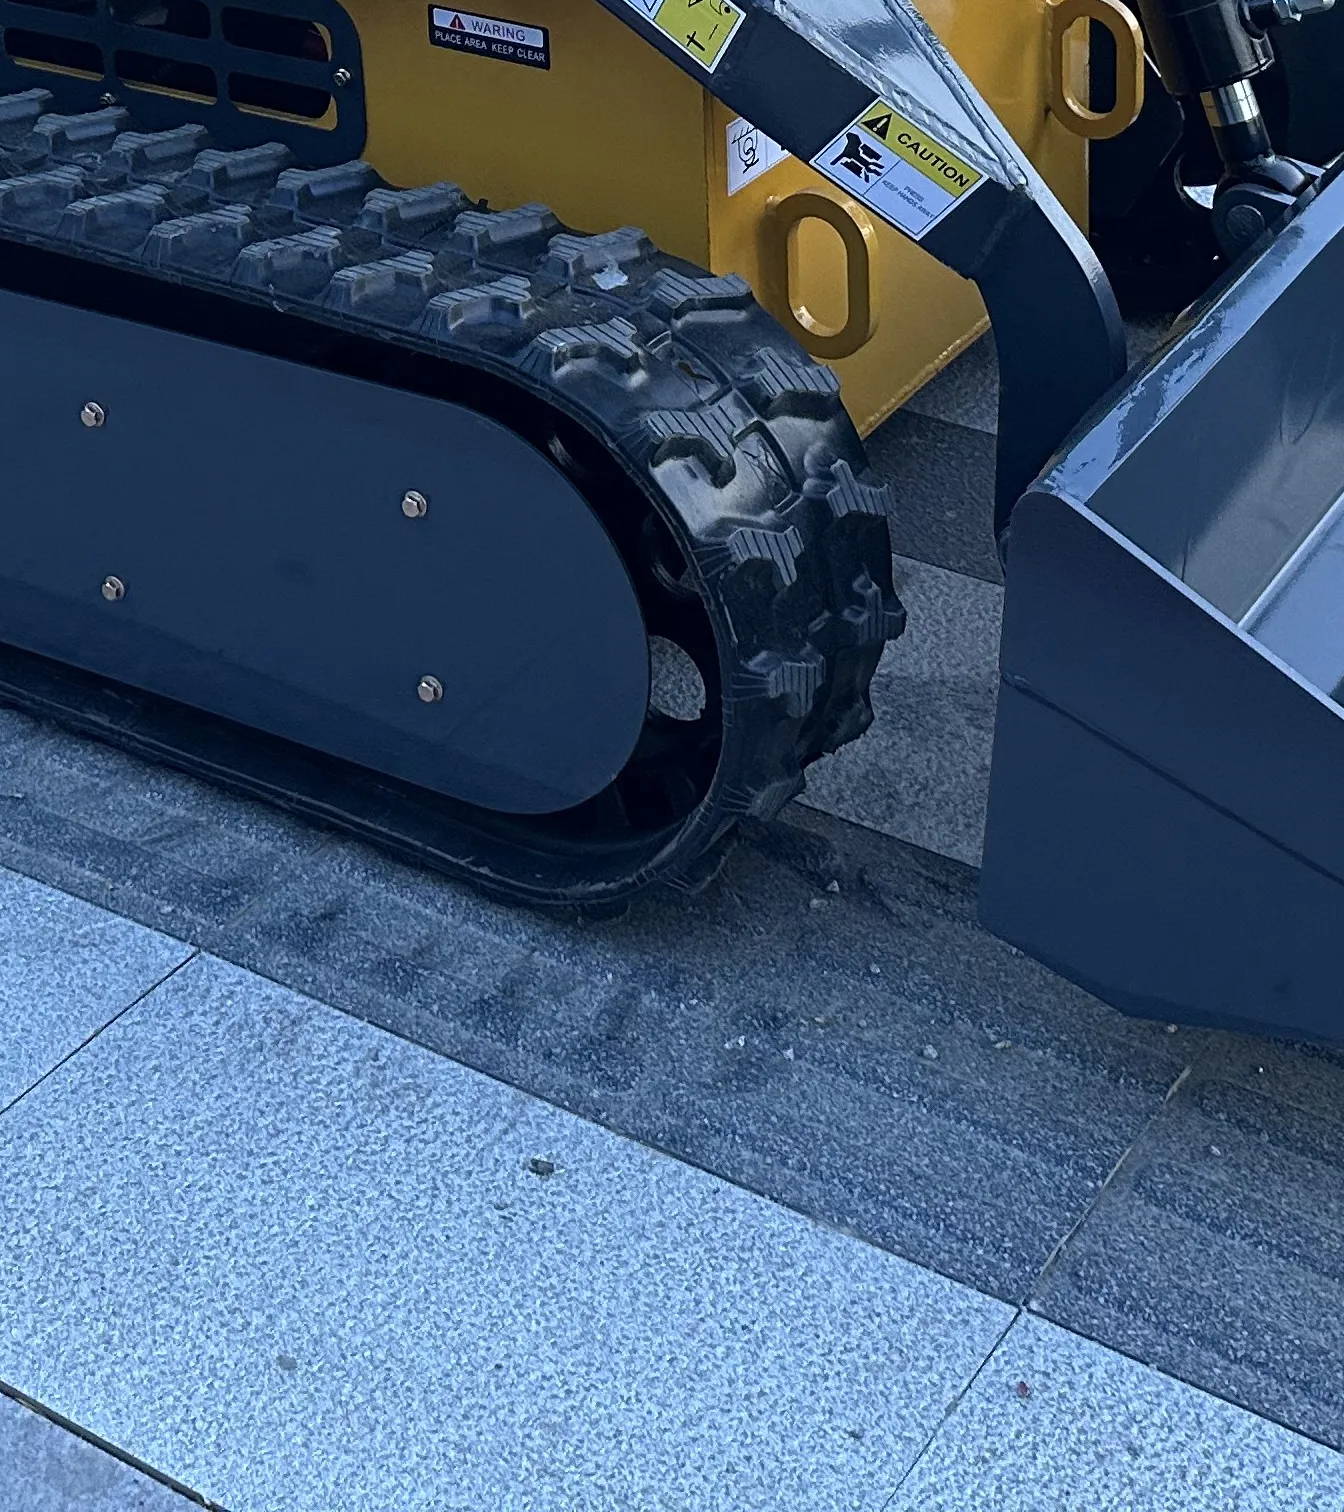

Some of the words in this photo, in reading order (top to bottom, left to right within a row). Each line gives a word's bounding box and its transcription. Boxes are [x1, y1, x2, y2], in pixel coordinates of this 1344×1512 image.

[435, 29, 462, 45] PLACE
[464, 36, 487, 50] AREA
[491, 42, 514, 55] KEEP
[517, 47, 545, 62] CLEAR
[471, 19, 526, 42] WARING
[897, 132, 970, 188] CAUTION
